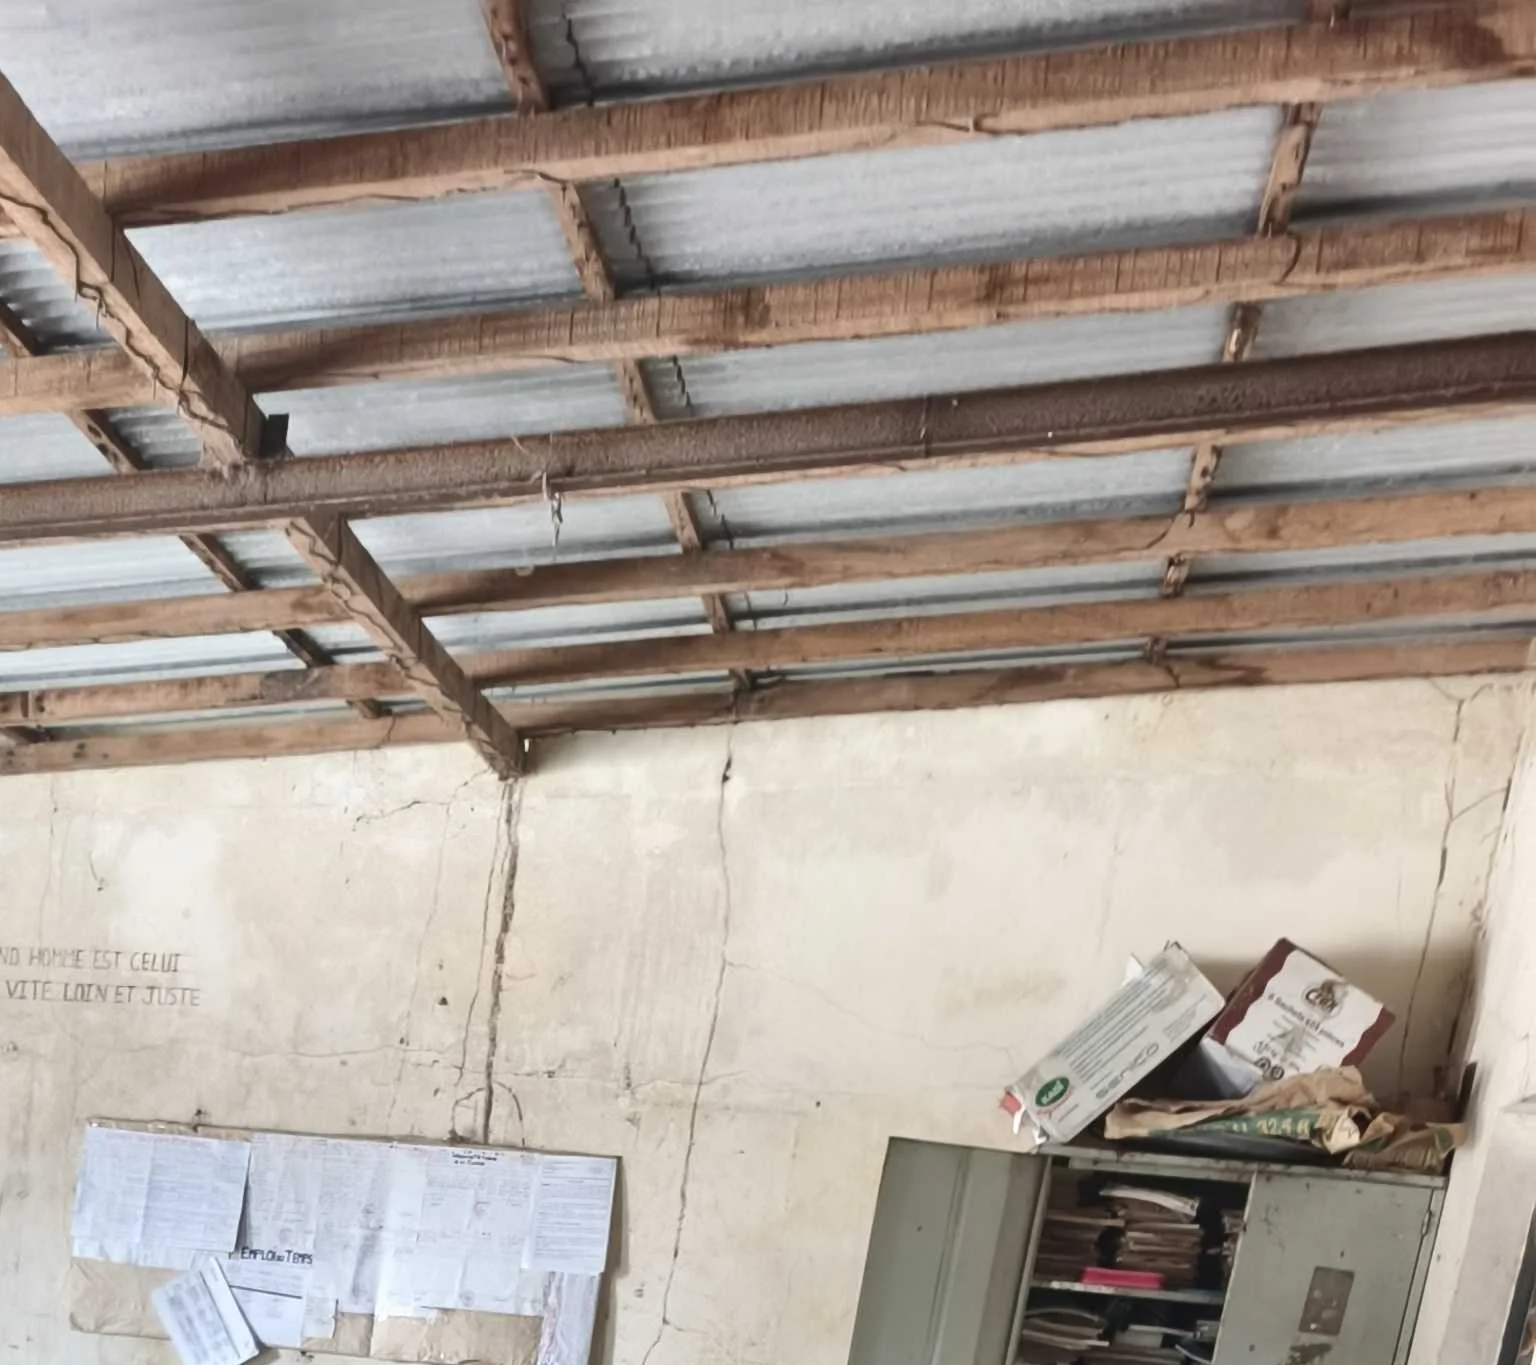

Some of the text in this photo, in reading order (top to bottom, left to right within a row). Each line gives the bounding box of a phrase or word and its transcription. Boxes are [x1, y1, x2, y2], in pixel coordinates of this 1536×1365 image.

[28, 946, 84, 970] HOMME
[92, 949, 123, 970] EST
[130, 951, 181, 973] CELUI
[5, 979, 52, 1001] VITE
[63, 982, 110, 1003] LOIN
[114, 985, 137, 1004] ET
[142, 985, 201, 1007] JUSTE
